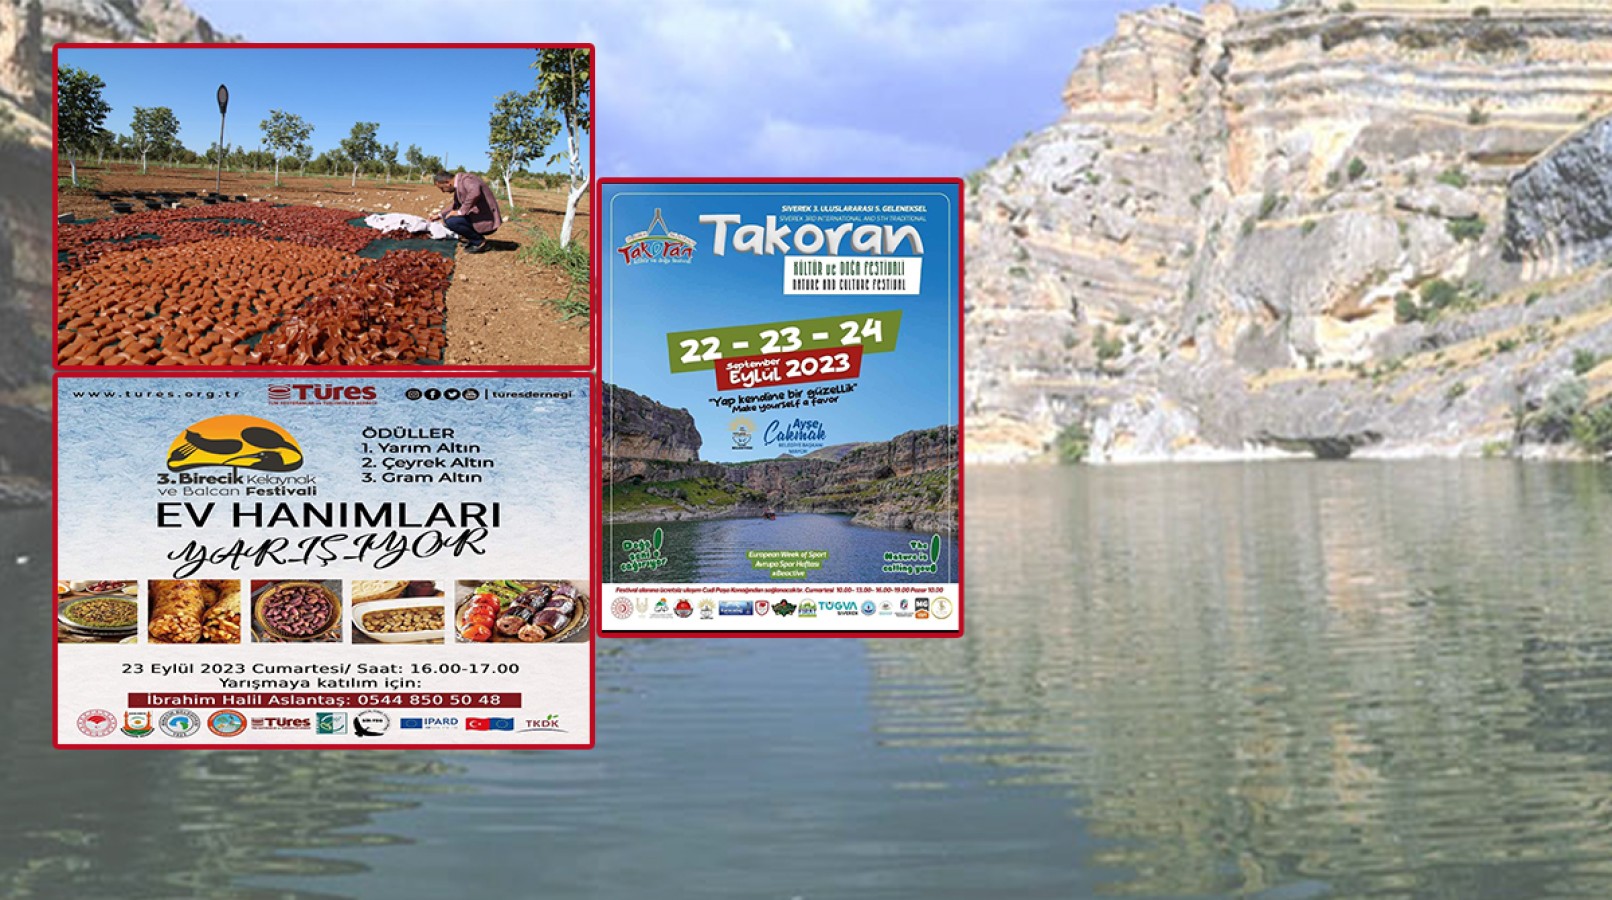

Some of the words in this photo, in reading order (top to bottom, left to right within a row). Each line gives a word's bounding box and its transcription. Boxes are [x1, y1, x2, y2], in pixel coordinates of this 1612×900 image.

[699, 214, 925, 256] Takoran
[679, 336, 723, 364] 22
[759, 326, 803, 355] 23
[839, 318, 883, 346] 24
[725, 358, 781, 372] September
[729, 368, 782, 388] Eylül
[785, 353, 851, 378] 2023
[73, 390, 242, 400] www.tures.org.tr
[292, 383, 378, 400] Türes
[738, 392, 785, 405] kendine
[787, 389, 803, 400] bir
[731, 404, 757, 413] Make
[759, 399, 801, 413] yourself
[811, 396, 839, 407] favor
[793, 418, 819, 431] Ayşe
[362, 426, 455, 439] ÖDÜLLER
[361, 443, 373, 453] 1.
[379, 443, 431, 453] Yarım
[437, 442, 481, 453] Altın
[361, 457, 377, 468] 2.
[382, 457, 446, 470] Çeyrek
[450, 457, 494, 468] Altın
[157, 473, 176, 485] 3.
[179, 471, 244, 485] Birecik
[246, 474, 317, 486] Kelaynak
[361, 472, 377, 483] 3.
[382, 472, 433, 483] Gram
[437, 472, 482, 483] Altın
[158, 487, 177, 496] ve
[183, 486, 240, 496] Balcan
[246, 486, 317, 496] Festivali
[157, 502, 216, 528] EV
[232, 502, 500, 528] HANIMLARI
[909, 540, 928, 550] The
[748, 551, 780, 559] European
[801, 551, 808, 559] of
[809, 551, 827, 559] Sport
[884, 551, 917, 561] Nature
[918, 551, 929, 561] is
[780, 560, 795, 568] Spor
[882, 563, 913, 575] calling
[121, 663, 144, 674] 23
[151, 662, 194, 676] Eylül
[200, 663, 246, 674] 2023
[252, 662, 351, 675] Cumartesi/
[356, 663, 403, 674] Saat:
[410, 663, 520, 674] 16.00-17.00
[219, 677, 311, 690] Yarışmaya
[317, 677, 378, 688] katılım
[385, 677, 422, 690] için:
[147, 693, 216, 706] İbrahim
[222, 694, 261, 706] Halil
[268, 694, 351, 707] Aslantaş:
[357, 694, 403, 706] 0544
[409, 694, 443, 706] 850
[449, 694, 472, 706] 50
[478, 694, 501, 706] 48
[264, 717, 311, 726] Türes
[423, 717, 459, 725] IPARD
[526, 719, 560, 728] TKDK
